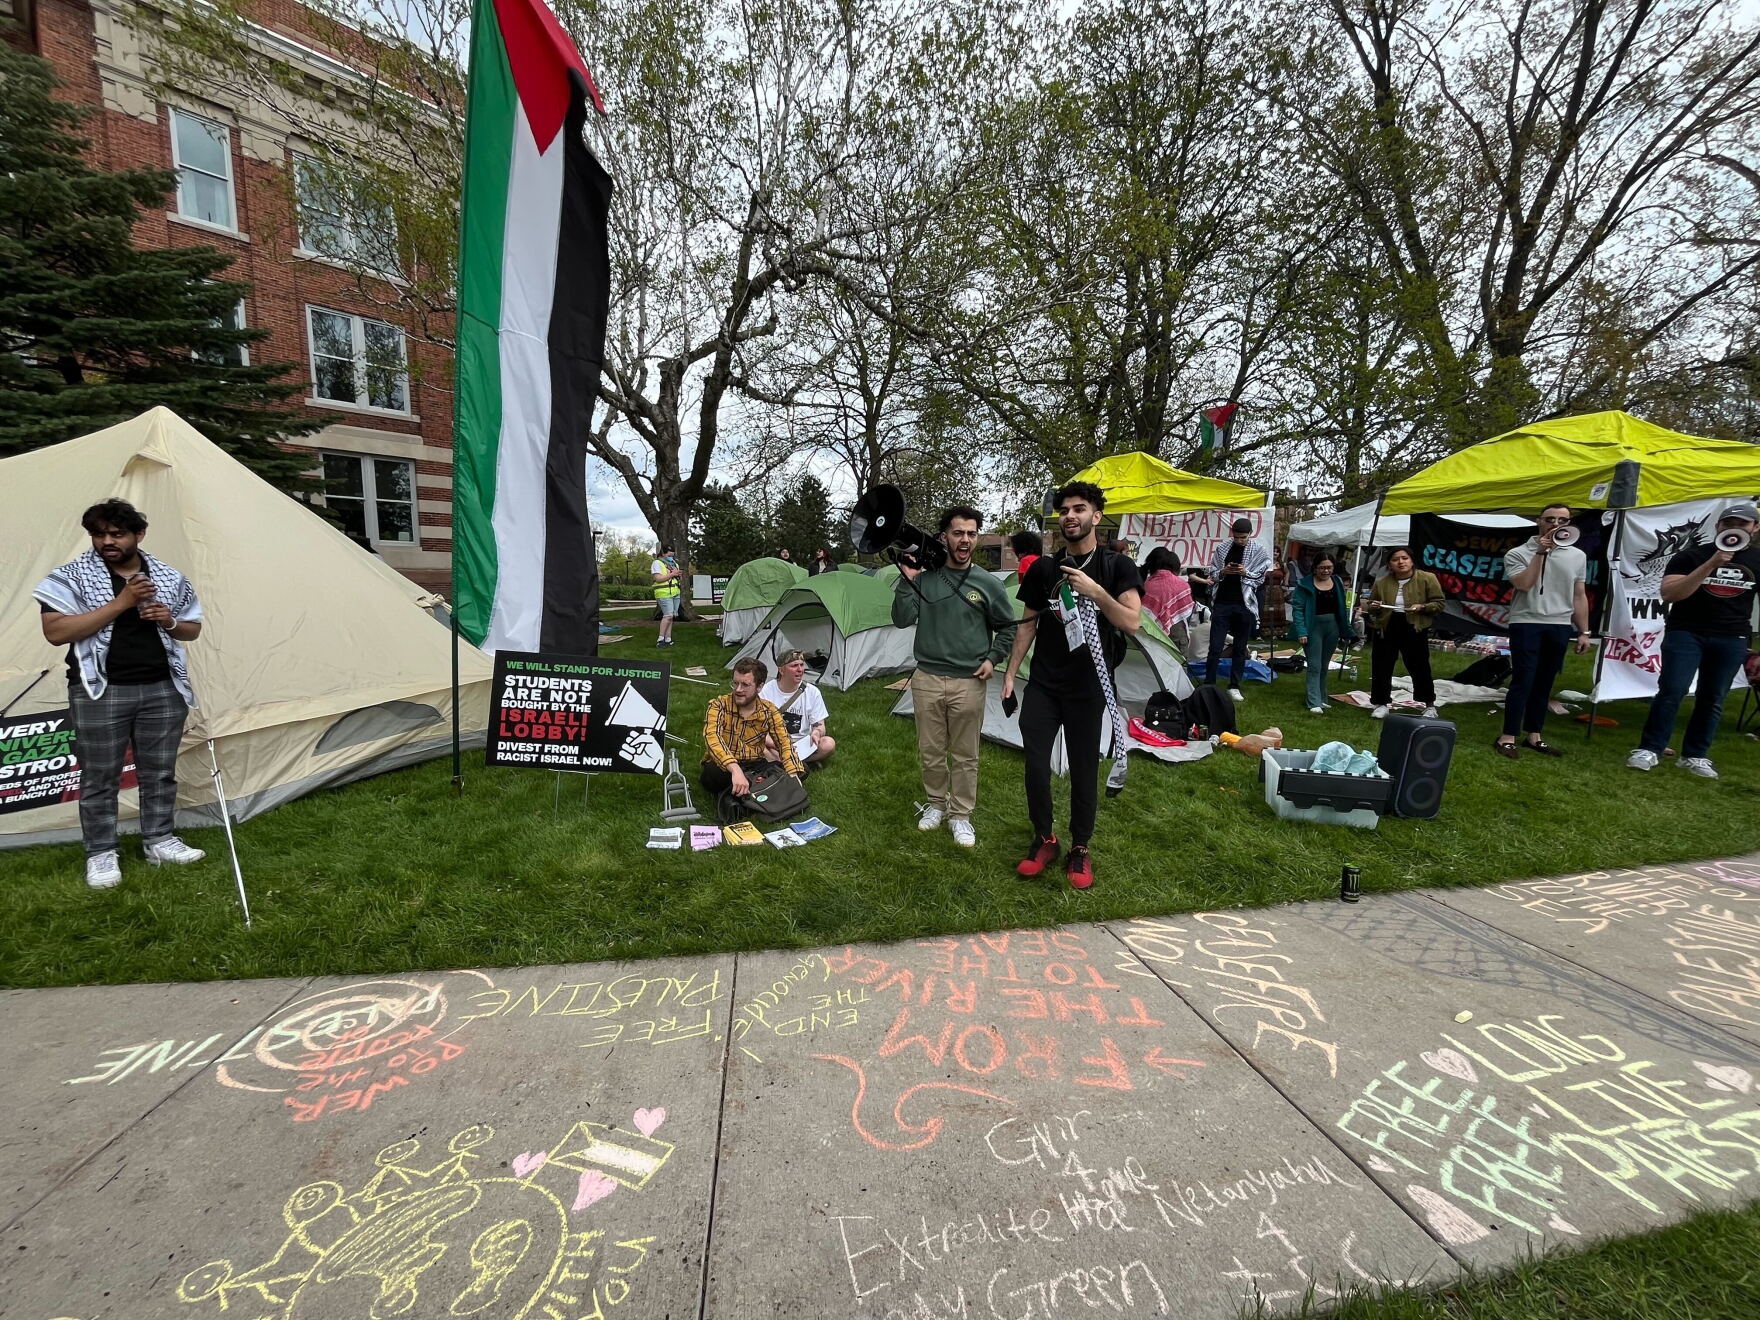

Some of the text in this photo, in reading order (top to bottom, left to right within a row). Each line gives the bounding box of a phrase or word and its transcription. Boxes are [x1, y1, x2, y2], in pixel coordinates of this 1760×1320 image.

[1423, 545, 1510, 580] CEASEF
[506, 661, 662, 679] WE WILL STAND FOR JUSTICE!
[504, 675, 593, 691] STUDENTS
[501, 699, 592, 713] BOUGHT BY THE
[502, 687, 591, 704] ARE NOT
[501, 708, 588, 726] ISRAELI
[0, 719, 64, 740] VERY
[500, 723, 588, 741] LOBBY!
[3, 743, 71, 764] GAZA
[497, 741, 579, 754] DIVEST FROM
[0, 754, 78, 779] STROY
[496, 752, 613, 767] RACIST ISRAEL NOW!
[0, 769, 83, 790] EDS OF PROFES
[28, 783, 51, 792] AND
[5, 791, 46, 803] BUNCH
[48, 787, 64, 796] OF
[66, 784, 81, 792] TE
[928, 951, 1120, 990] TO THE
[465, 968, 724, 1018] PALESTINE
[828, 947, 1166, 1027] THE RIVER
[808, 988, 872, 1010] THE
[774, 1008, 858, 1036] END
[878, 1008, 1136, 1090] FROM
[1440, 1015, 1626, 1083] LONG
[1525, 1060, 1738, 1137] LIVE
[1336, 1060, 1475, 1174] FREE
[1439, 1095, 1567, 1235] FREE
